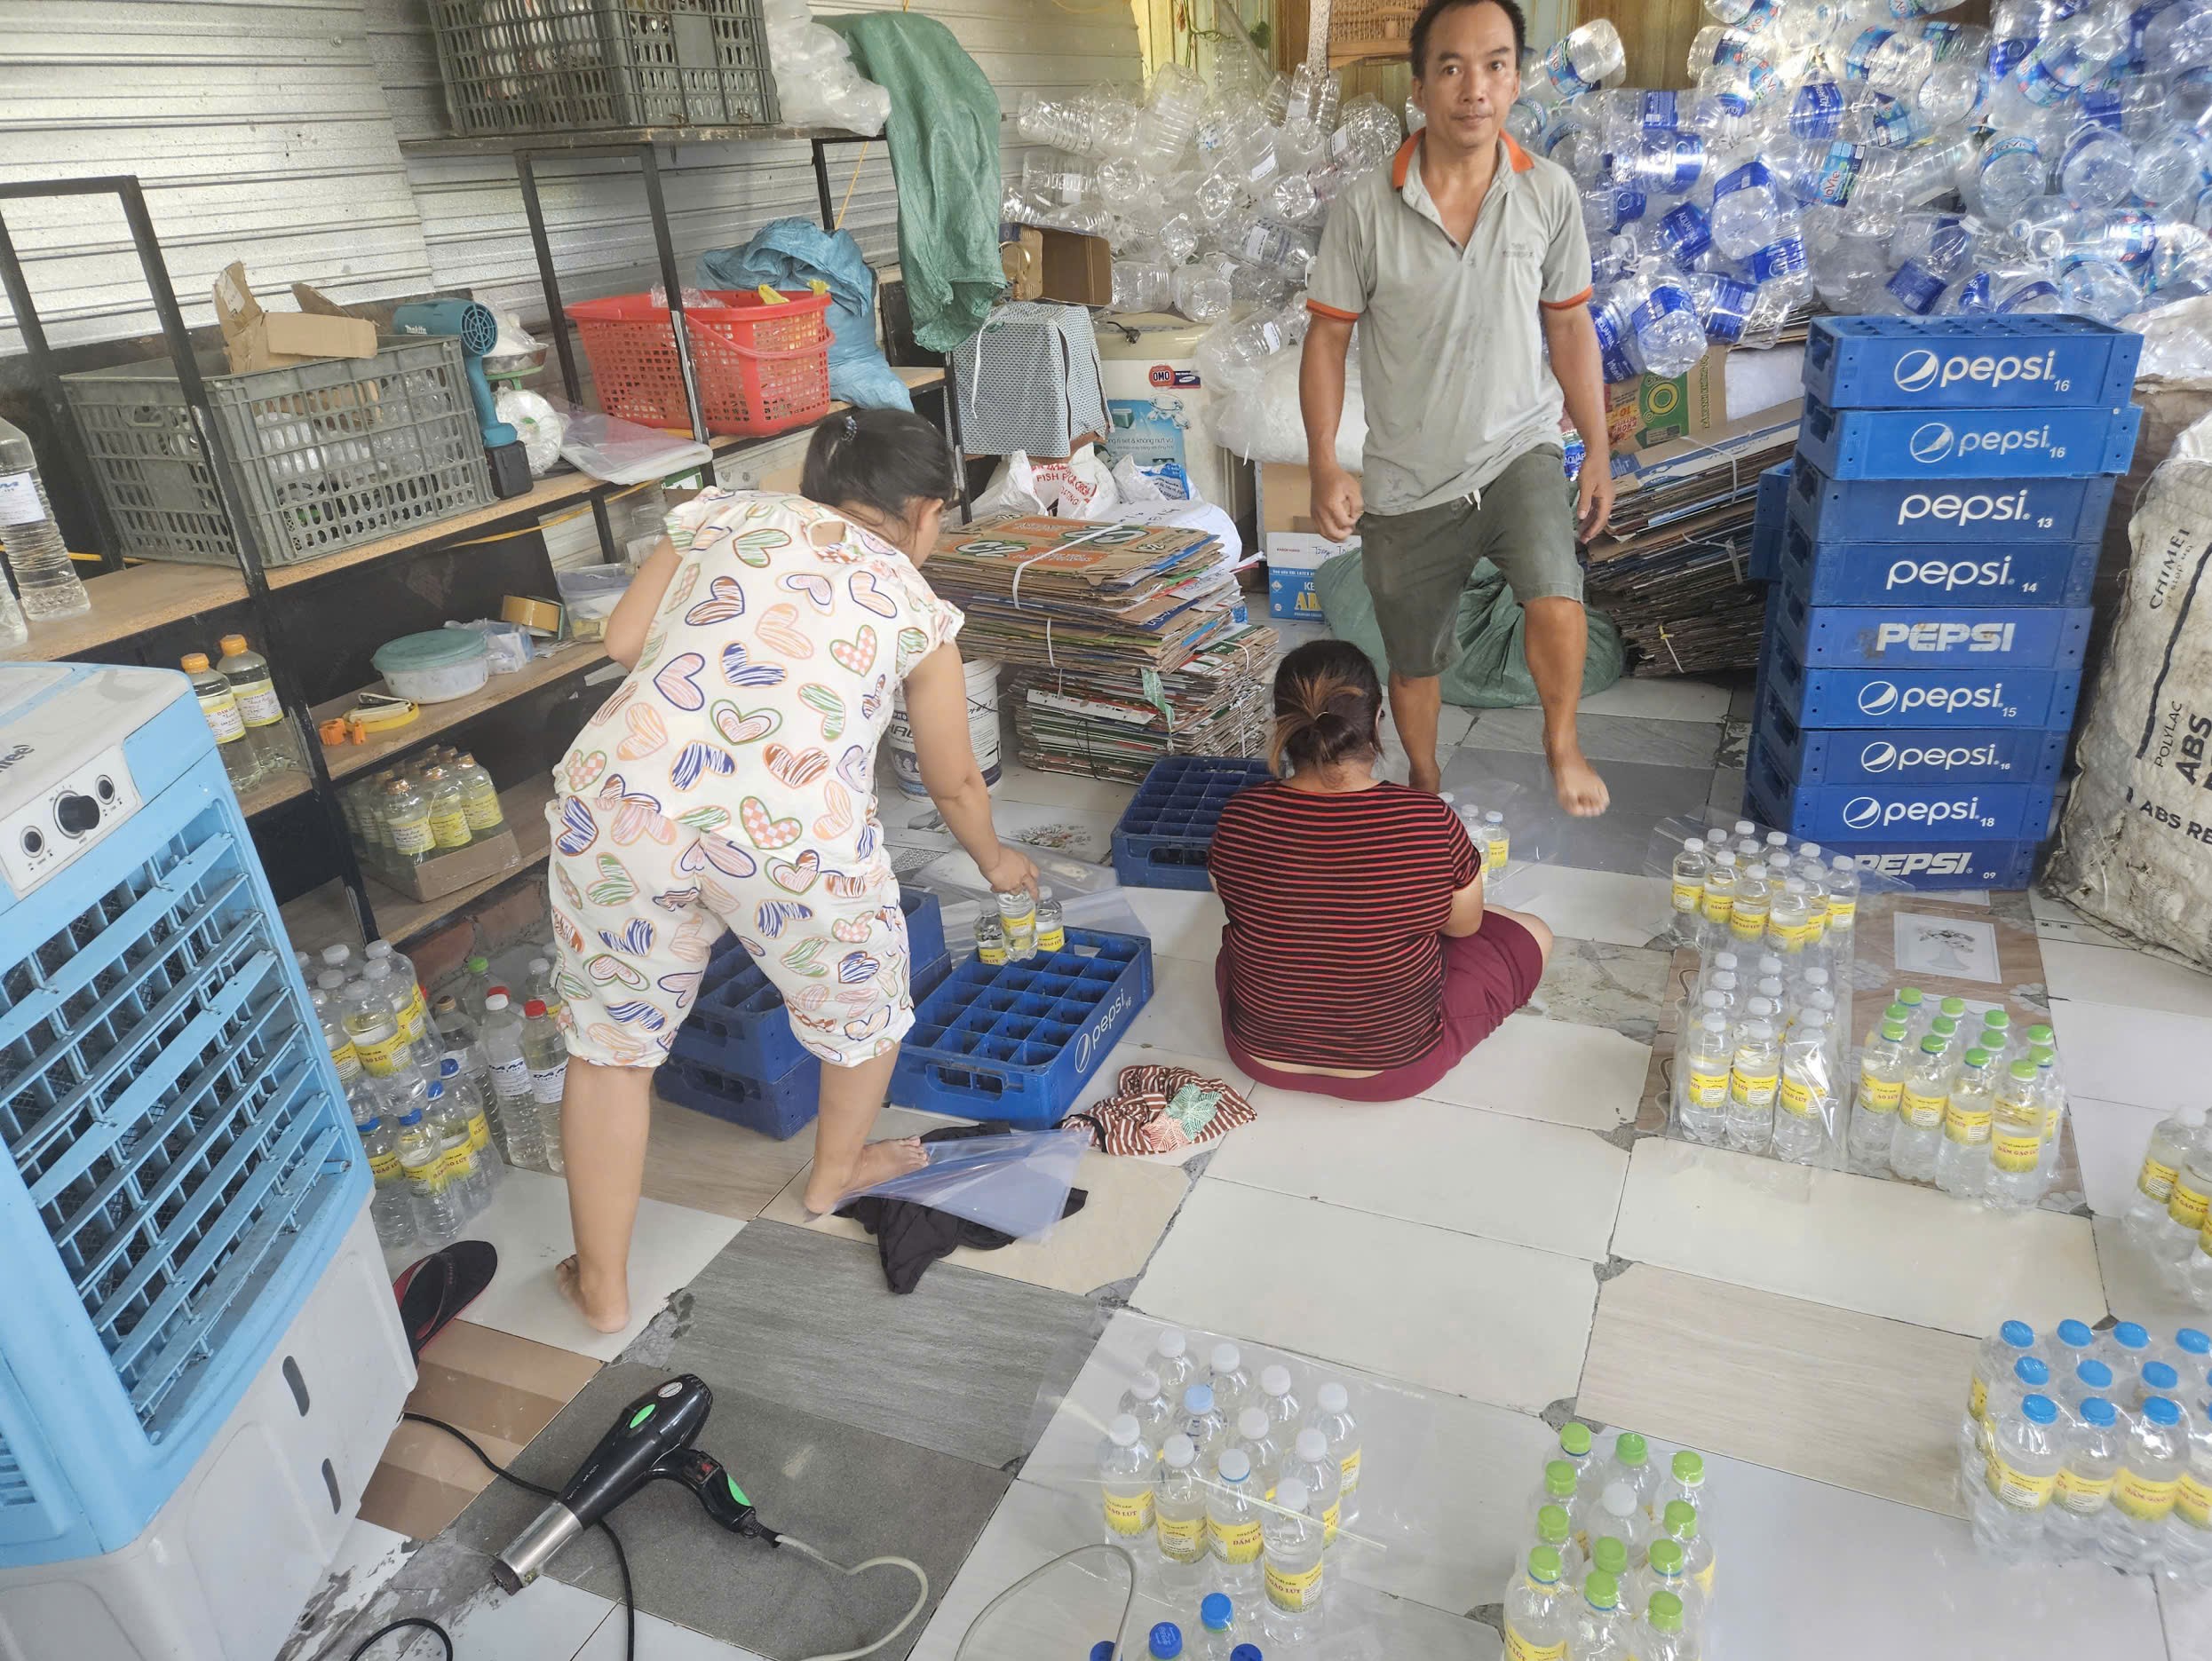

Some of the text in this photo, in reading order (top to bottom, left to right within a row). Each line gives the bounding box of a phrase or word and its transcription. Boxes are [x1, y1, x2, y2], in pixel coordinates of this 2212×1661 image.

[1676, 212, 1698, 245] AQUAFINA
[1153, 371, 1171, 382] OMO
[1940, 351, 2070, 392] pepsi 16
[1957, 424, 2066, 458] pepsi 16
[1898, 489, 2053, 528] pepsi 13
[1885, 555, 2038, 593] pepsi 14
[2149, 528, 2191, 610] CHIMEI
[1875, 623, 2017, 652] PEPSI
[1900, 683, 2018, 717] pepsi 15
[2154, 700, 2183, 768] POLYLAC
[2176, 713, 2212, 786] ABS
[1898, 744, 1996, 771] pepsi
[1883, 796, 1995, 827] pepsi 18
[2139, 800, 2181, 829] ABS
[1091, 988, 1125, 1049] pepsi
